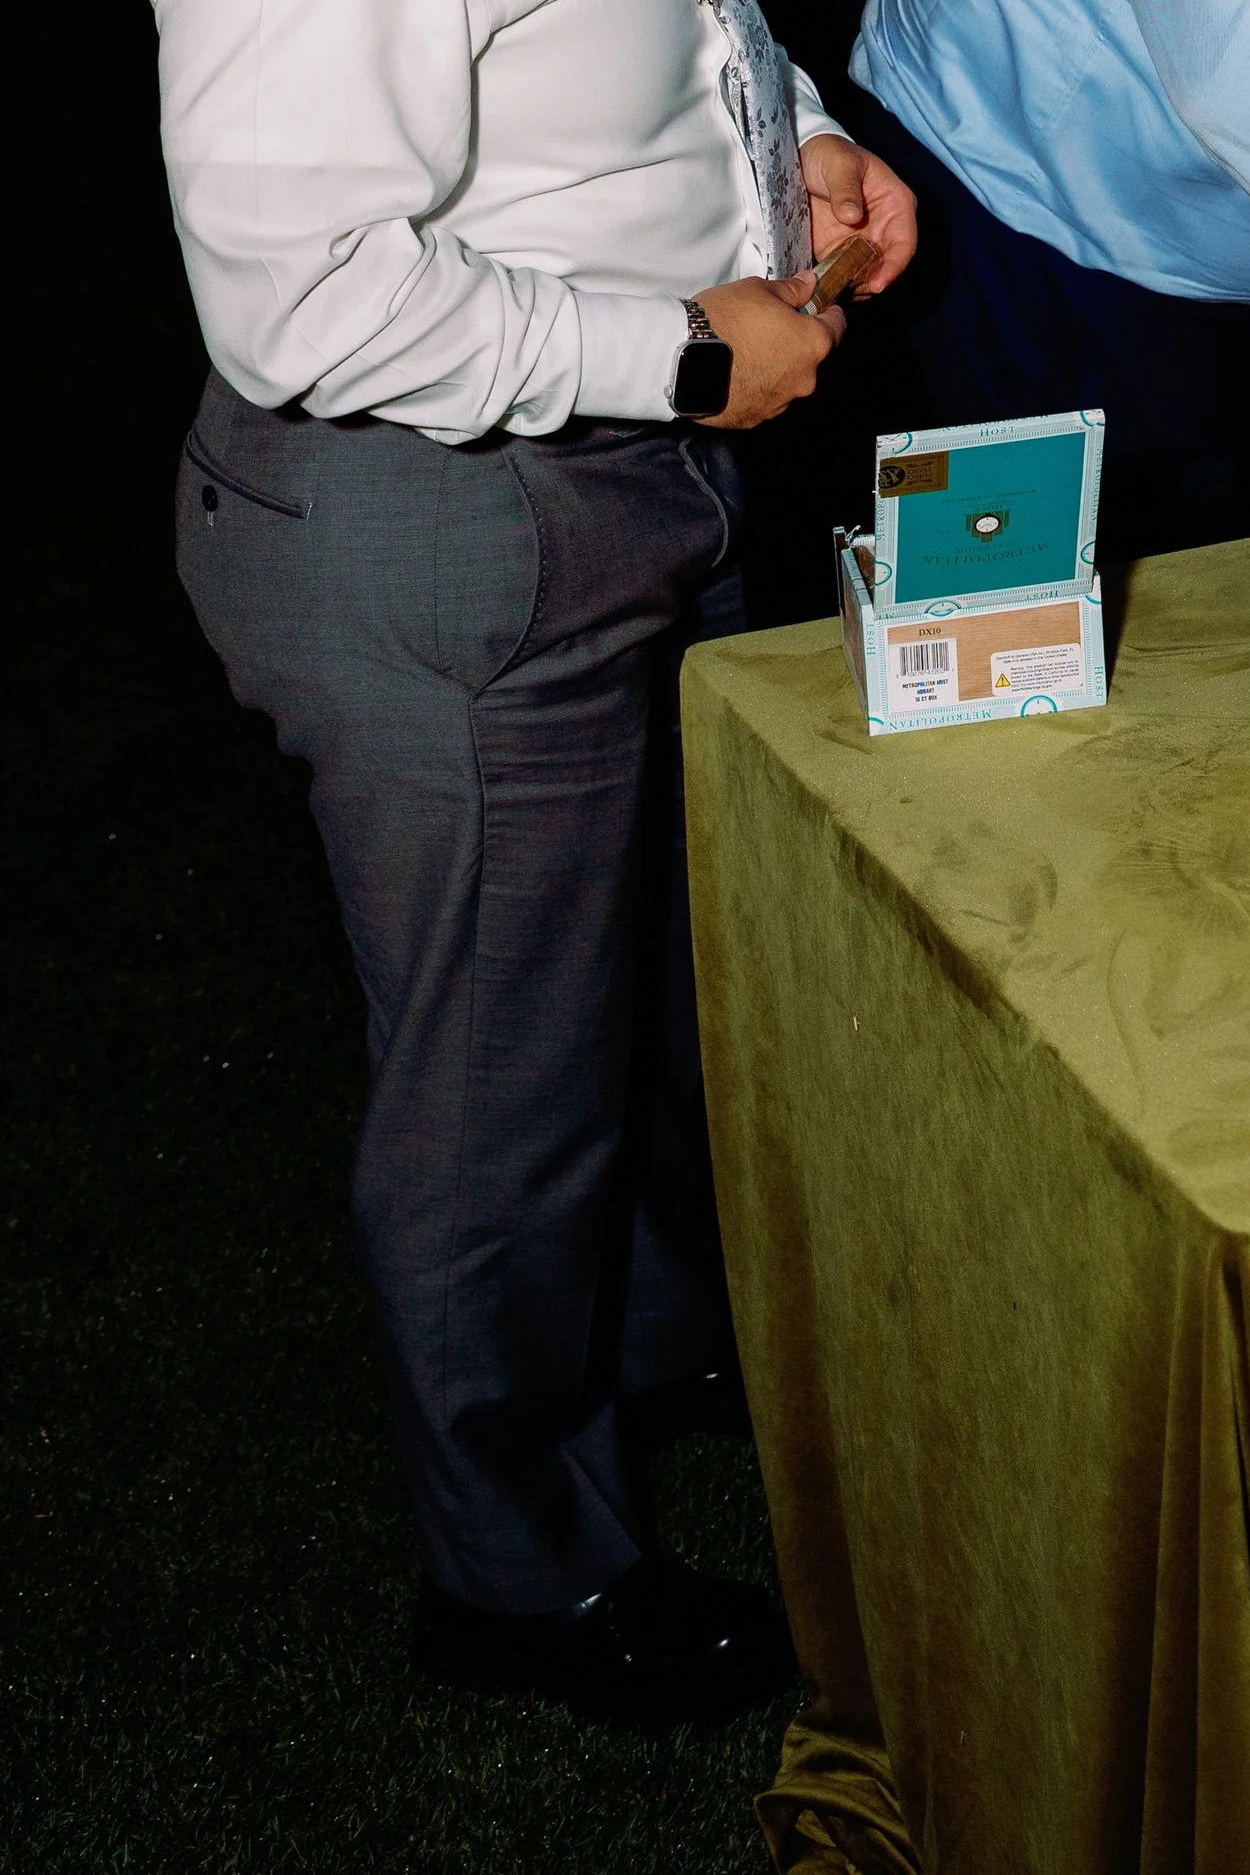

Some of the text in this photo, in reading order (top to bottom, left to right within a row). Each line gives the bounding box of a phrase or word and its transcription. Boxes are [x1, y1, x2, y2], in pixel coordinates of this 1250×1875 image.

[866, 624, 876, 656] HOST
[918, 627, 942, 636] DX10
[902, 681, 936, 689] METROPOLITAN
[1094, 666, 1104, 699] HOST
[889, 709, 992, 731] METROPOLITAN
